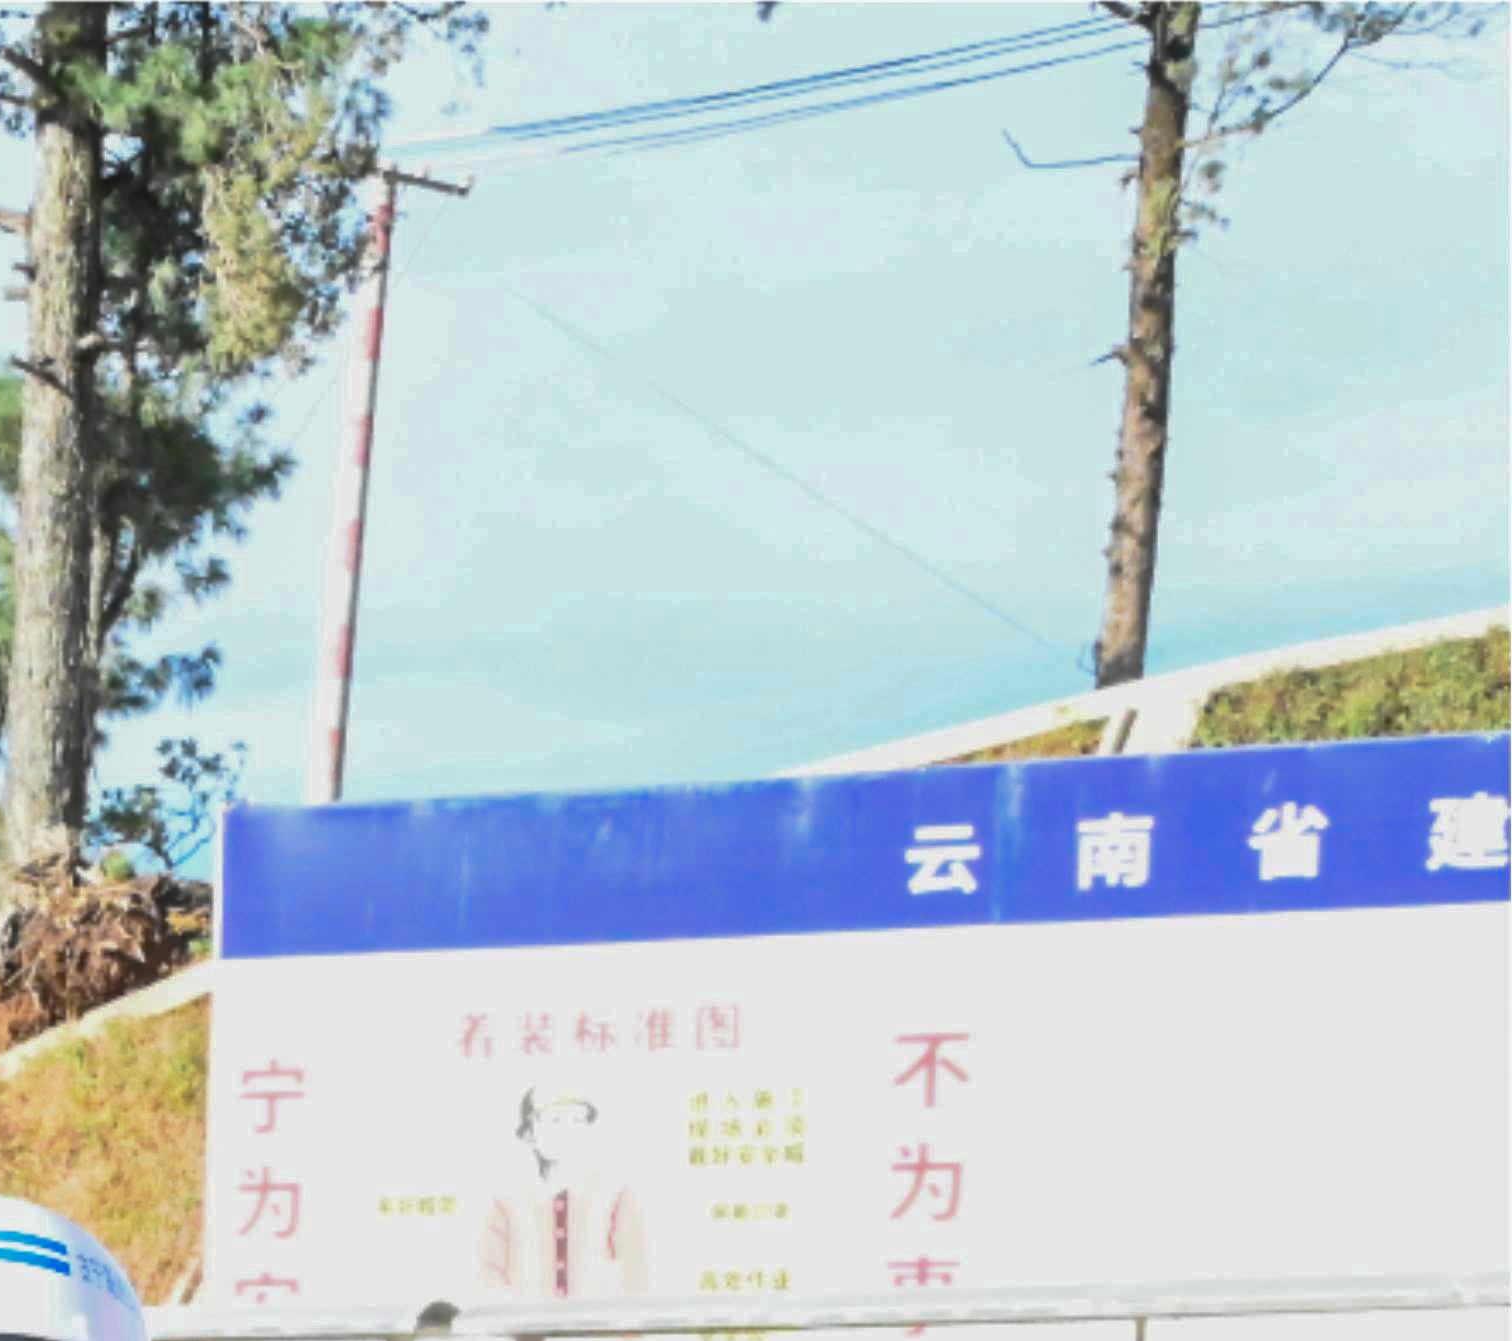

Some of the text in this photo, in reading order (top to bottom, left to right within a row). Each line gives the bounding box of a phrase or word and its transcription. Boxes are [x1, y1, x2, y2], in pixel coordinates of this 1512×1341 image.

[457, 1004, 742, 1058] 着装标准图
